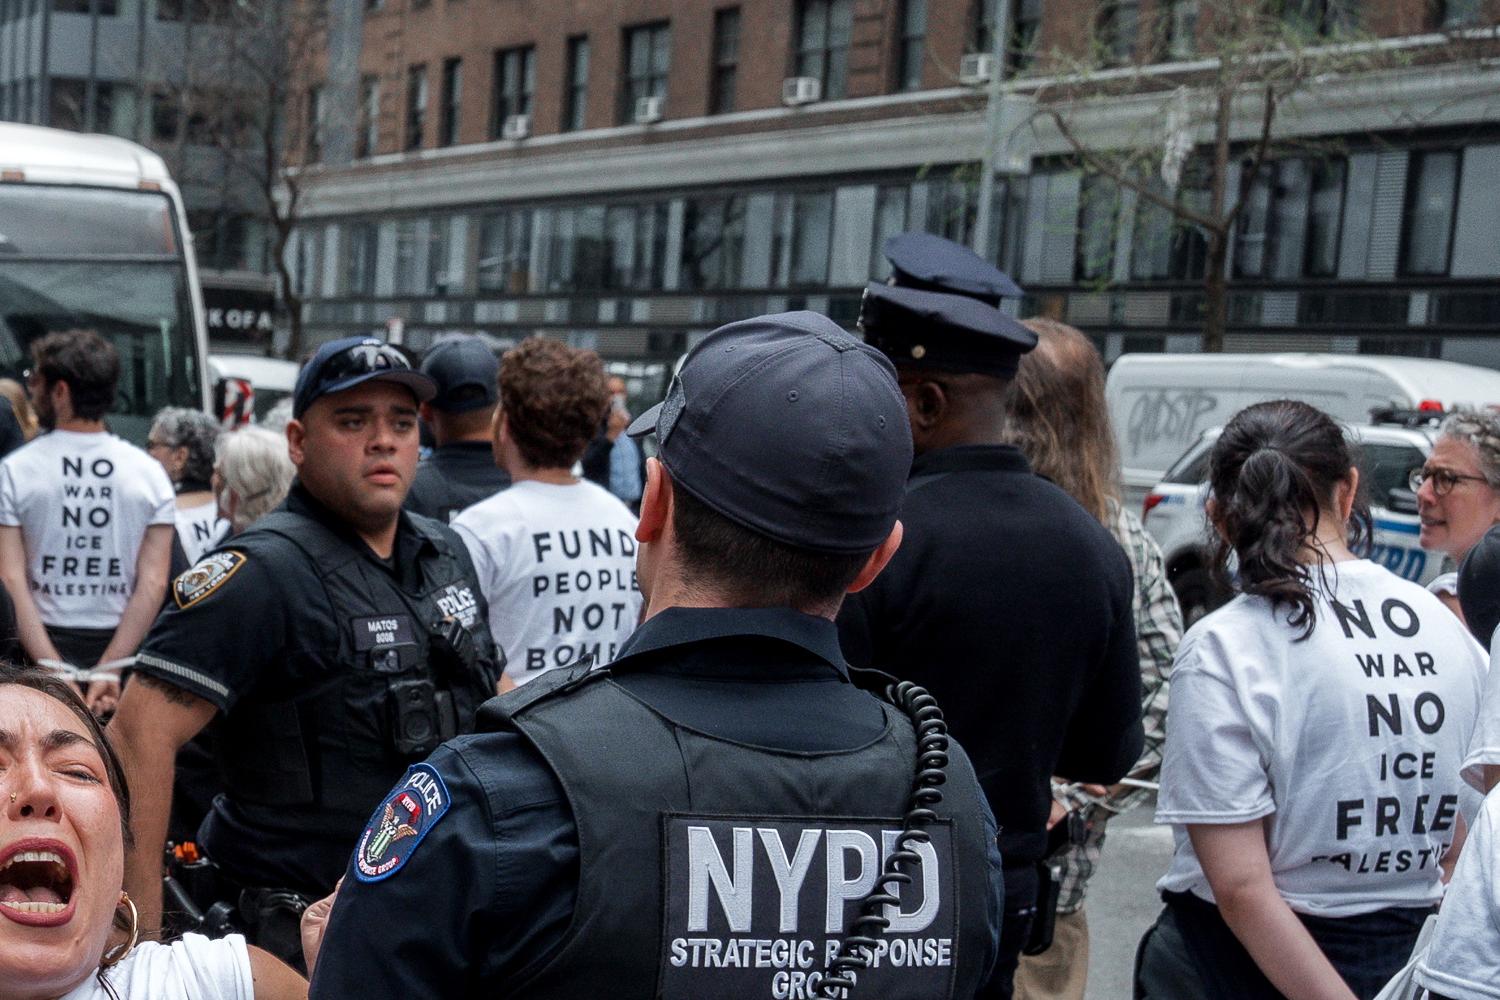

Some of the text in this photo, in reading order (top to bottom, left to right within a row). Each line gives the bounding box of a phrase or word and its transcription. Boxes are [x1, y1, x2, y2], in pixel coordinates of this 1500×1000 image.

[61, 456, 114, 478] NO
[64, 485, 113, 499] WAR
[61, 506, 110, 528] NO
[66, 536, 102, 550] ICE
[532, 528, 636, 563] FUND
[42, 555, 121, 577] FREE
[367, 619, 399, 632] MATOS
[552, 602, 626, 635] NOT
[1330, 597, 1421, 638] NO
[1355, 652, 1438, 678] WAR
[1366, 691, 1446, 737] NO
[1380, 752, 1436, 781] ICE
[403, 771, 442, 816] POLICE
[687, 826, 941, 934] NYPD
[670, 937, 814, 969] STRATEGIC
